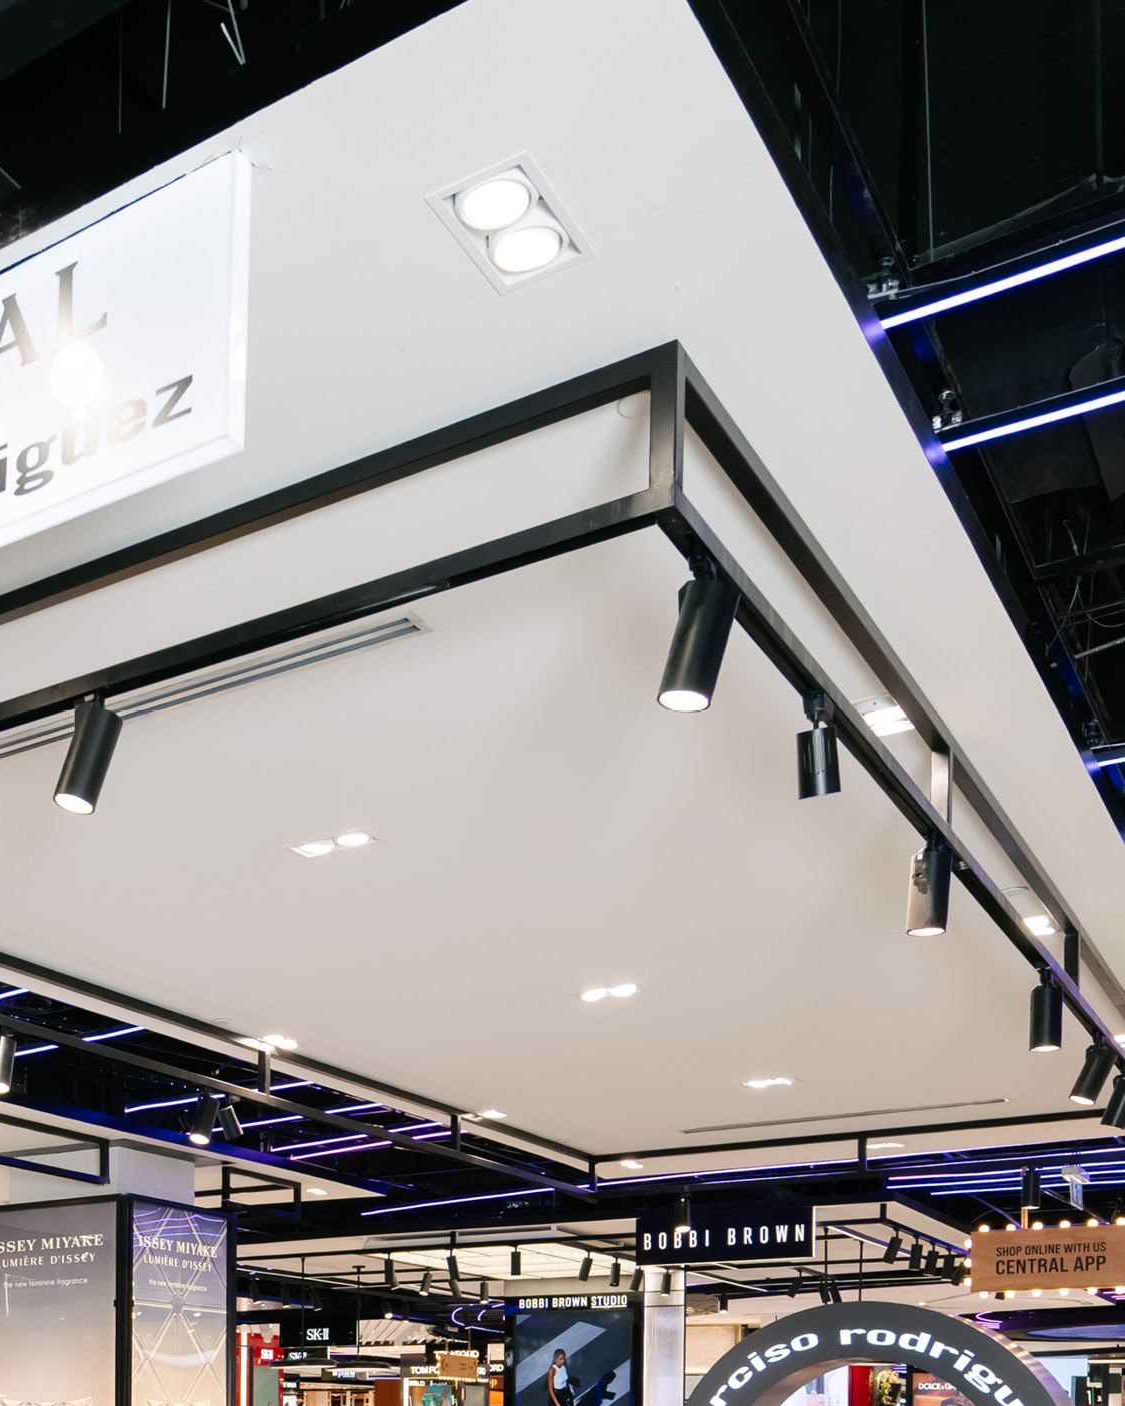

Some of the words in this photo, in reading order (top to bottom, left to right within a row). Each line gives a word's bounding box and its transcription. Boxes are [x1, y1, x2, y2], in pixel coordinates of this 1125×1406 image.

[41, 1234, 103, 1250] MIYAKE
[643, 1229, 710, 1251] BOBBI
[727, 1224, 805, 1246] BROWN
[138, 1235, 173, 1251] ISSEY
[176, 1241, 217, 1258] MIYAKE
[996, 1247, 1022, 1256] SHOP
[1025, 1244, 1061, 1255] ONLINE
[1064, 1242, 1090, 1253] WITH
[1093, 1242, 1106, 1252] US
[50, 1252, 95, 1264] D'ISSEY
[144, 1254, 179, 1268] LUMIÈRE
[996, 1257, 1069, 1275] CENTRAL
[1073, 1255, 1106, 1272] APP
[29, 1279, 55, 1287] feminine
[56, 1278, 88, 1286] fragrance
[519, 1298, 549, 1309] BOBBI
[552, 1297, 588, 1308] BROWN
[591, 1295, 628, 1307] STUDIO
[306, 1328, 329, 1341] SK-II
[410, 1366, 428, 1374] TOM
